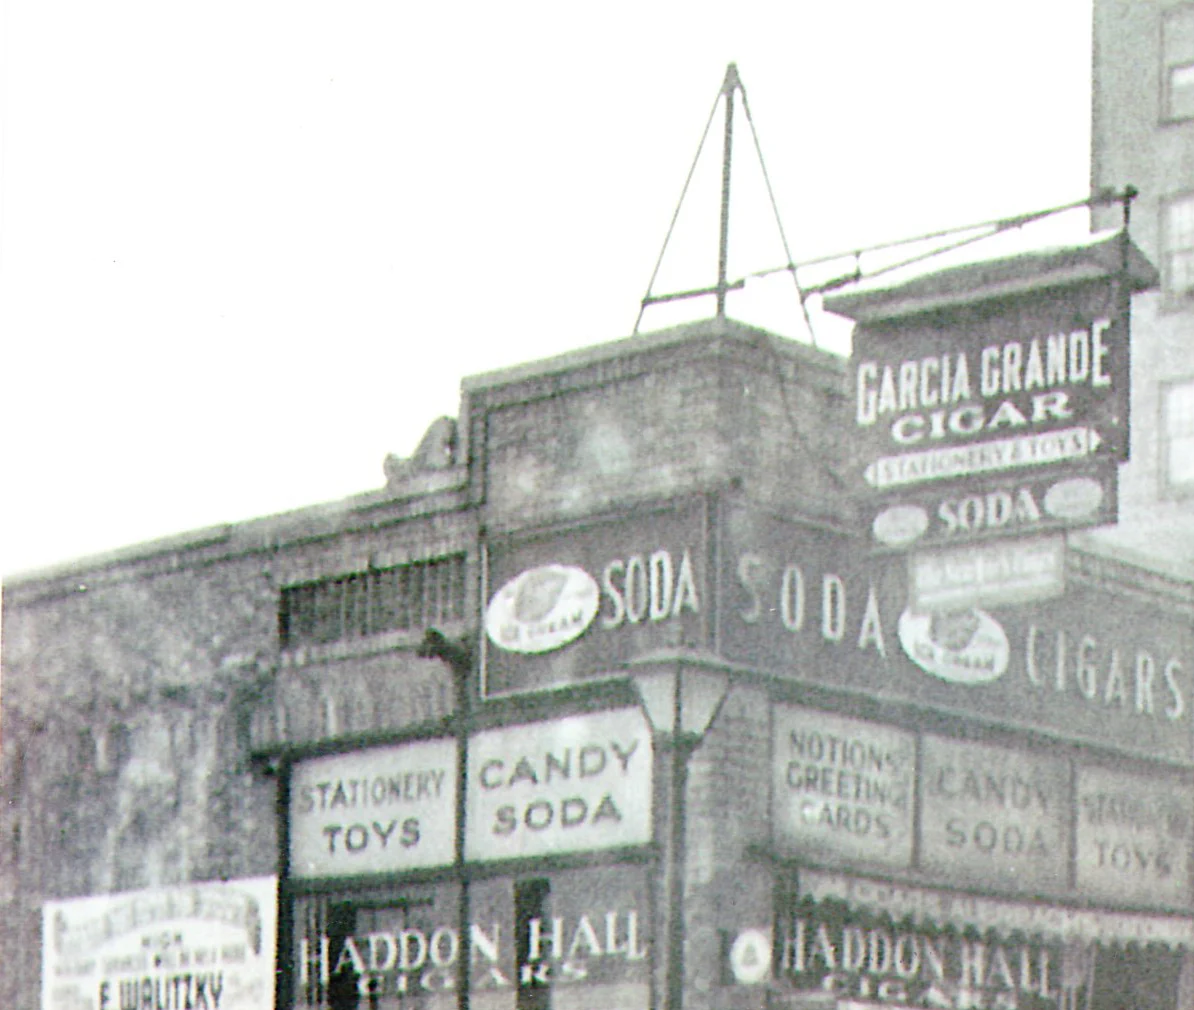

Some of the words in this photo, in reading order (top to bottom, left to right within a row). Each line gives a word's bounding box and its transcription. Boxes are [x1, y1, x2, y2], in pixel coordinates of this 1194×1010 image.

[857, 352, 971, 425] GARCIA
[981, 319, 1113, 397] GRANDE
[892, 391, 1075, 444] CIGAR
[938, 487, 1042, 536] SODA
[602, 549, 700, 630] SODA
[736, 551, 889, 659] SODA
[1025, 624, 1185, 720] CIGARS
[478, 738, 639, 790] CANDY
[299, 769, 446, 815] STATIONERY
[492, 793, 623, 837] SODA
[322, 817, 421, 857] TOYS
[800, 800, 892, 841] CARDS
[944, 816, 1050, 859] SODA
[1092, 838, 1173, 879] TOYS
[299, 922, 501, 989] HADDON
[528, 910, 648, 962] HALL
[779, 916, 946, 980] HADDON
[960, 939, 1050, 999] HALL
